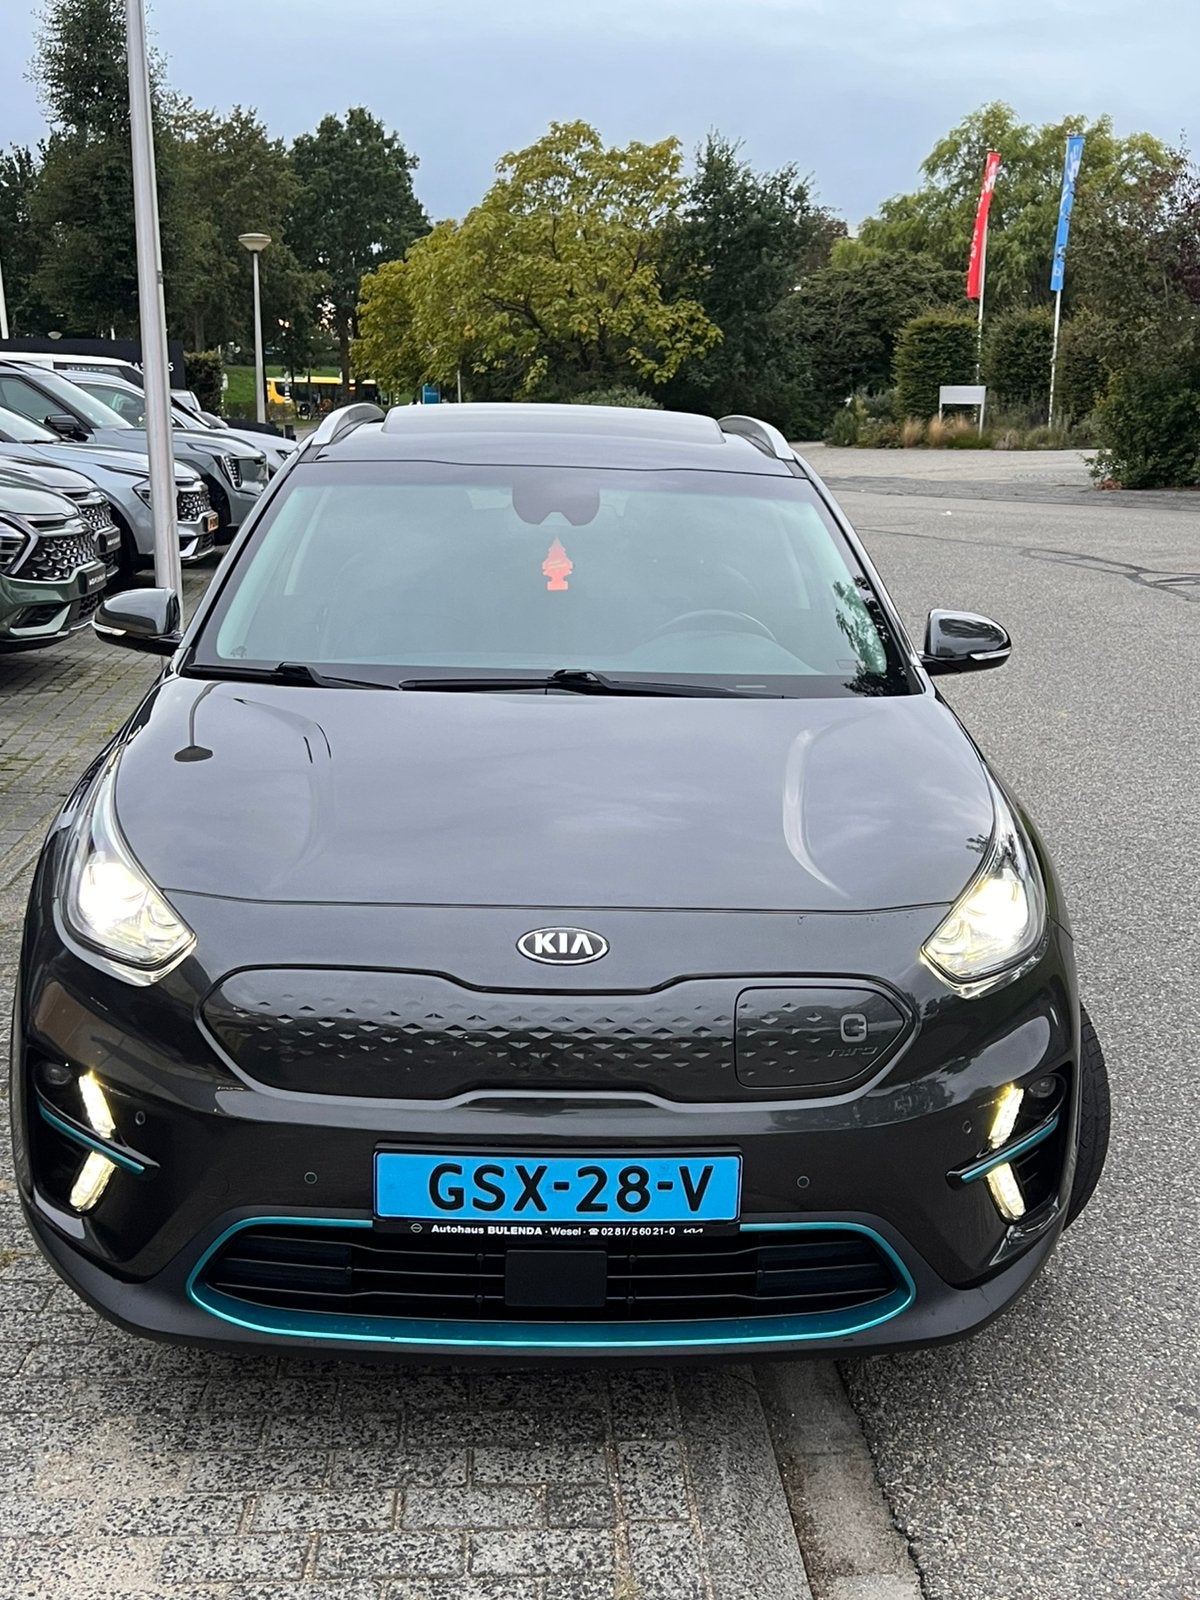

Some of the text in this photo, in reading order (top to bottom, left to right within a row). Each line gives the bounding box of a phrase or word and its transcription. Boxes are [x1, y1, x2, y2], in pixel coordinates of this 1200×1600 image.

[534, 932, 594, 955] KIA
[427, 1162, 714, 1214] GSX-28-V
[431, 1224, 485, 1235] Autohaus
[487, 1225, 543, 1236] BULENDA
[550, 1226, 582, 1236] Wesel
